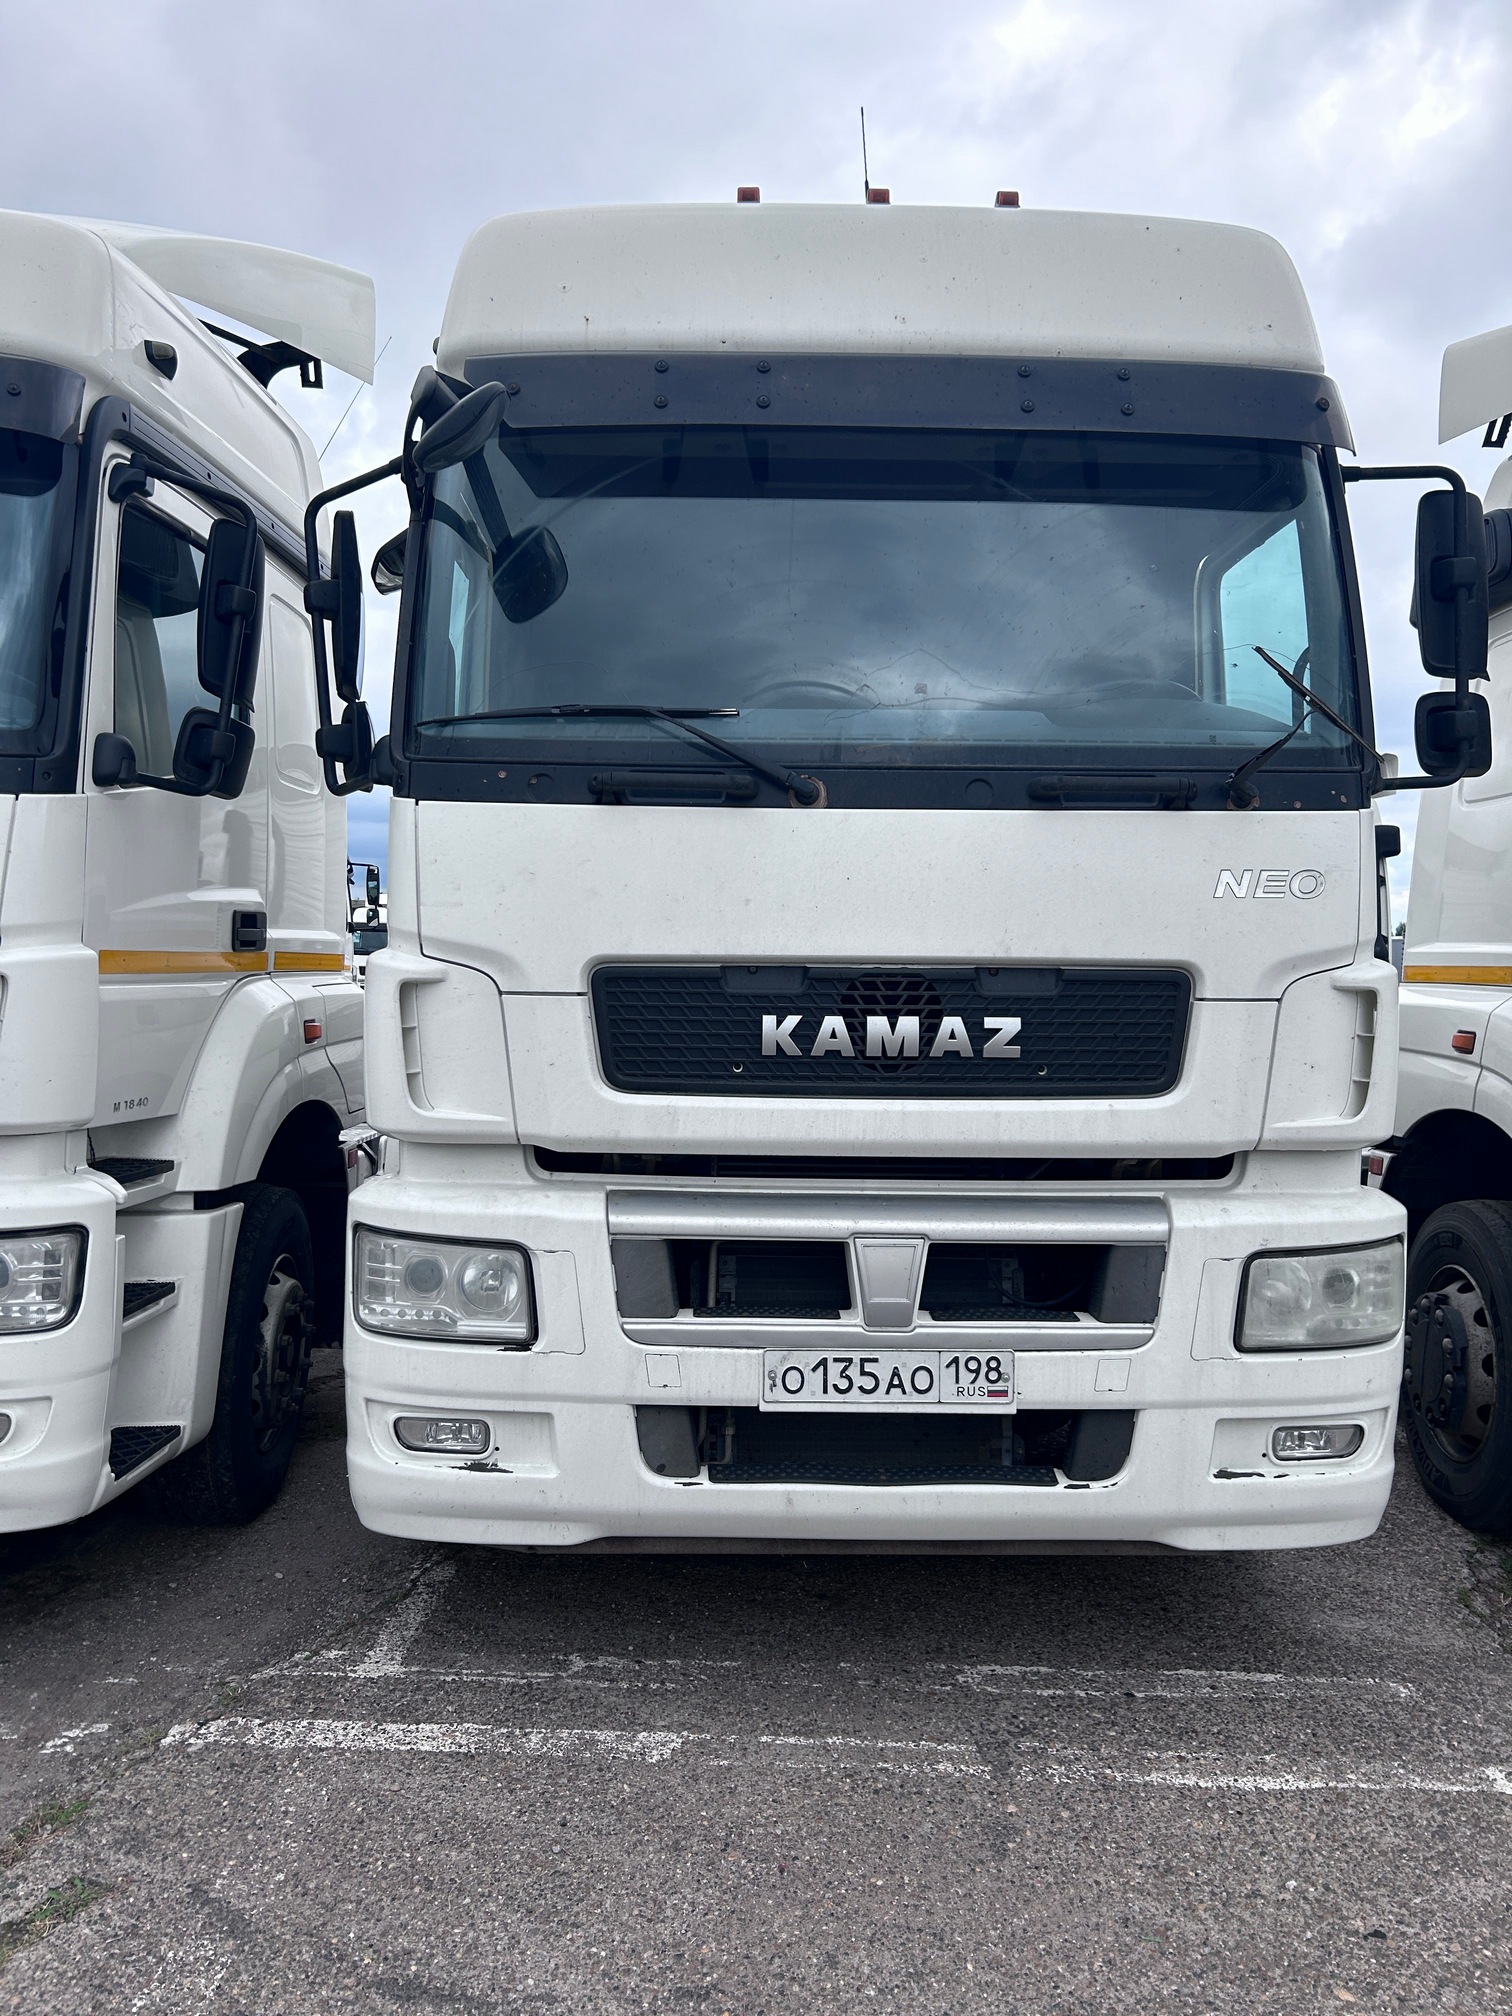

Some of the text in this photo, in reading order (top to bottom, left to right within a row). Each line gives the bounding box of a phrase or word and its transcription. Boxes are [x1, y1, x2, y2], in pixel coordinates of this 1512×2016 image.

[1213, 869, 1326, 900] NEO
[761, 1014, 1022, 1058] KAMAZ
[781, 1355, 1002, 1395] O135AO 198
[956, 1386, 986, 1397] RUS
